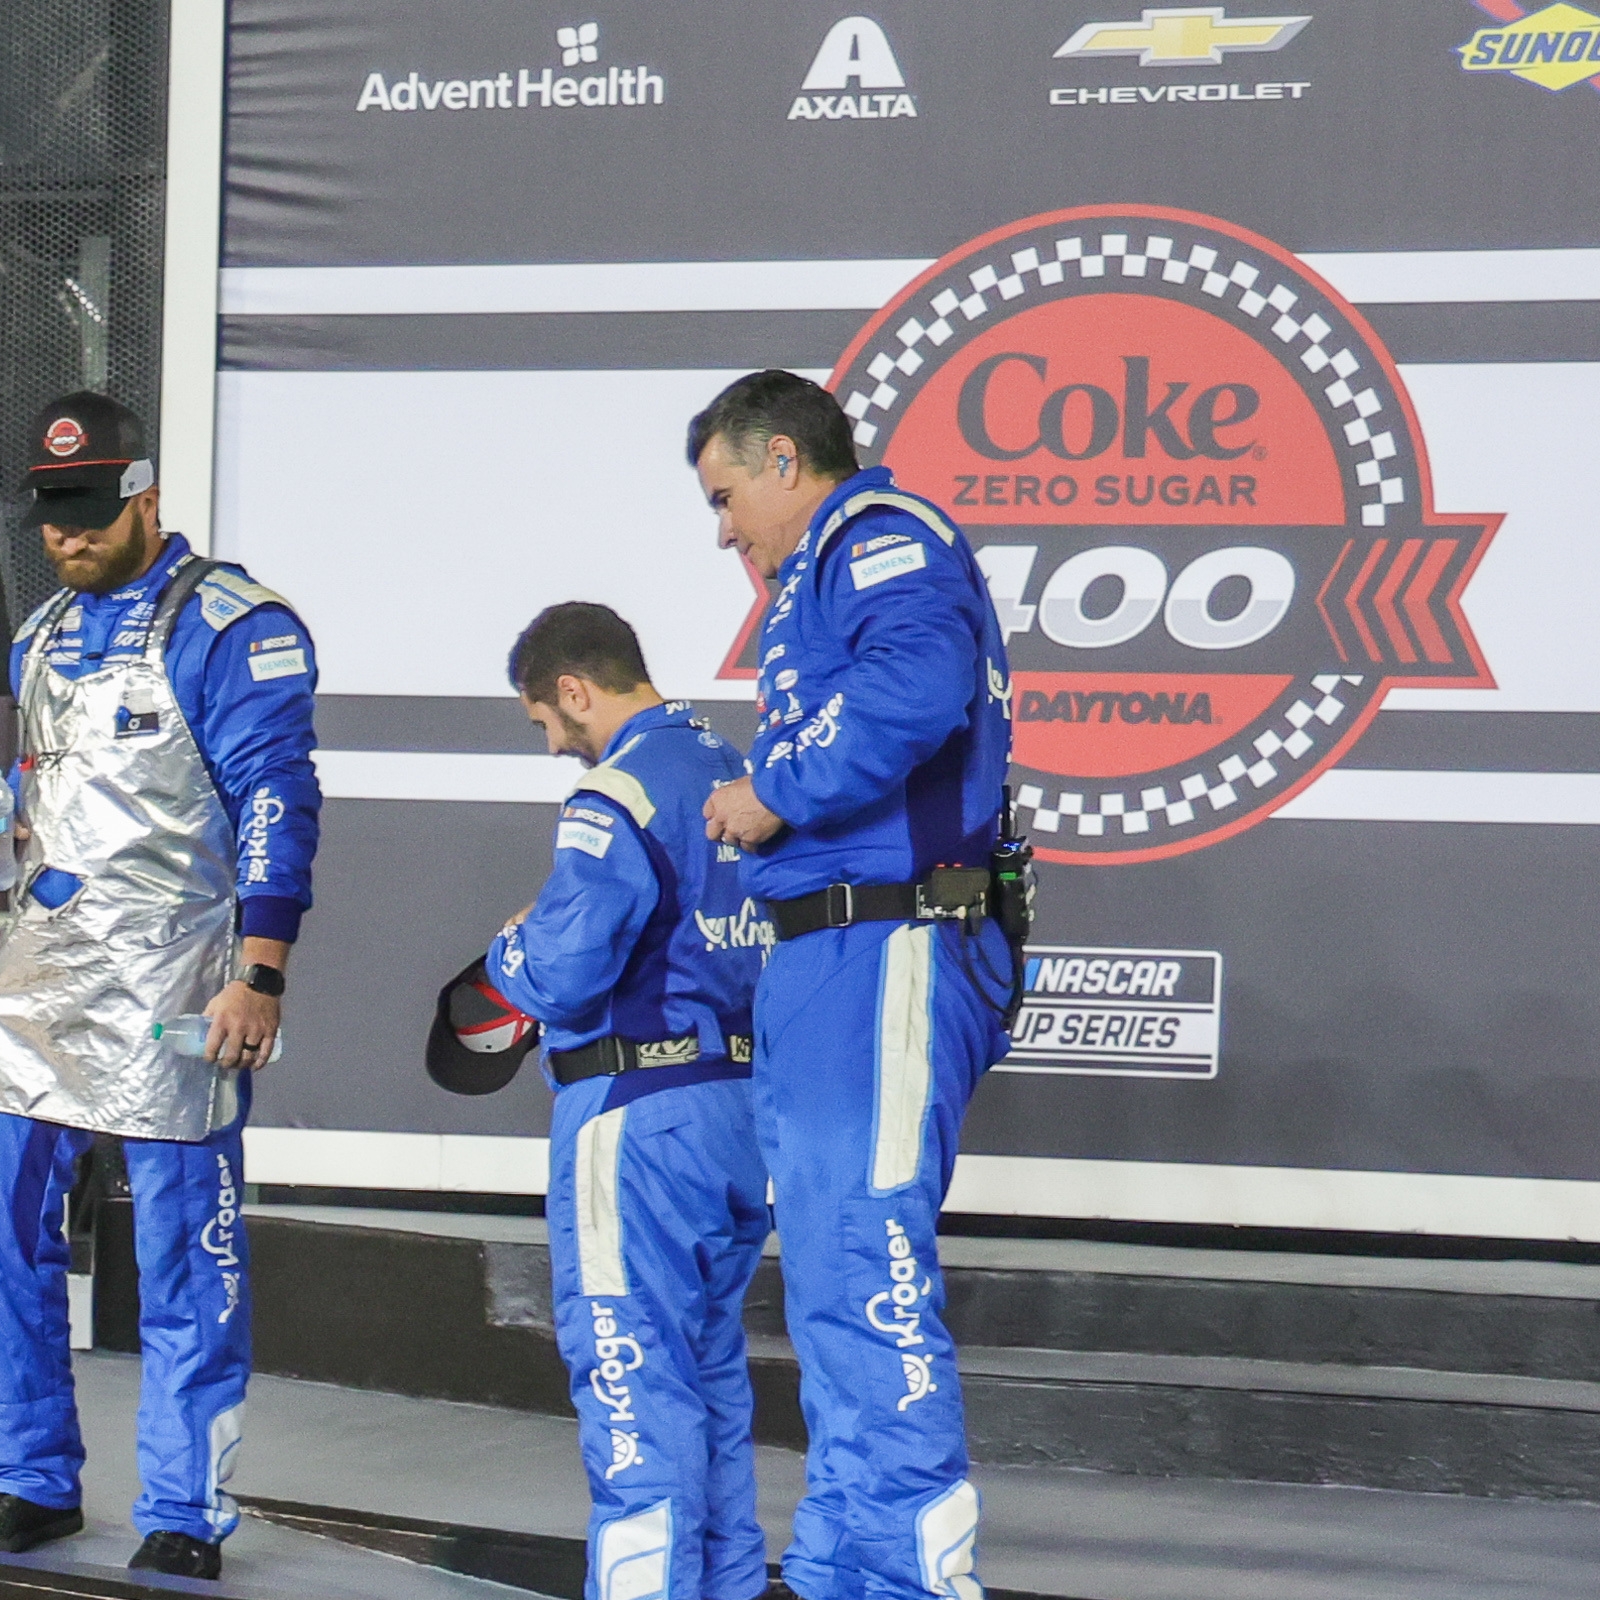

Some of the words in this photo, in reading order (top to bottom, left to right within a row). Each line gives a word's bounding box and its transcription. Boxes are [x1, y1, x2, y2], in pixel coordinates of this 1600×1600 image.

[787, 93, 917, 120] AXALTA
[1049, 82, 1311, 105] CHEVROLET
[957, 351, 1260, 462] Coke
[952, 474, 1078, 506] ZERO
[1094, 473, 1258, 506] SUGAR
[861, 554, 915, 578] SIEMENS
[974, 545, 1296, 649] 400
[1020, 692, 1217, 724] DAYTONA
[1034, 958, 1180, 997] NASCAR
[1010, 1012, 1061, 1044] UP
[1066, 1014, 1181, 1049] SERIES
[866, 1218, 931, 1348] Kroger
[591, 1301, 644, 1423] Kroger
